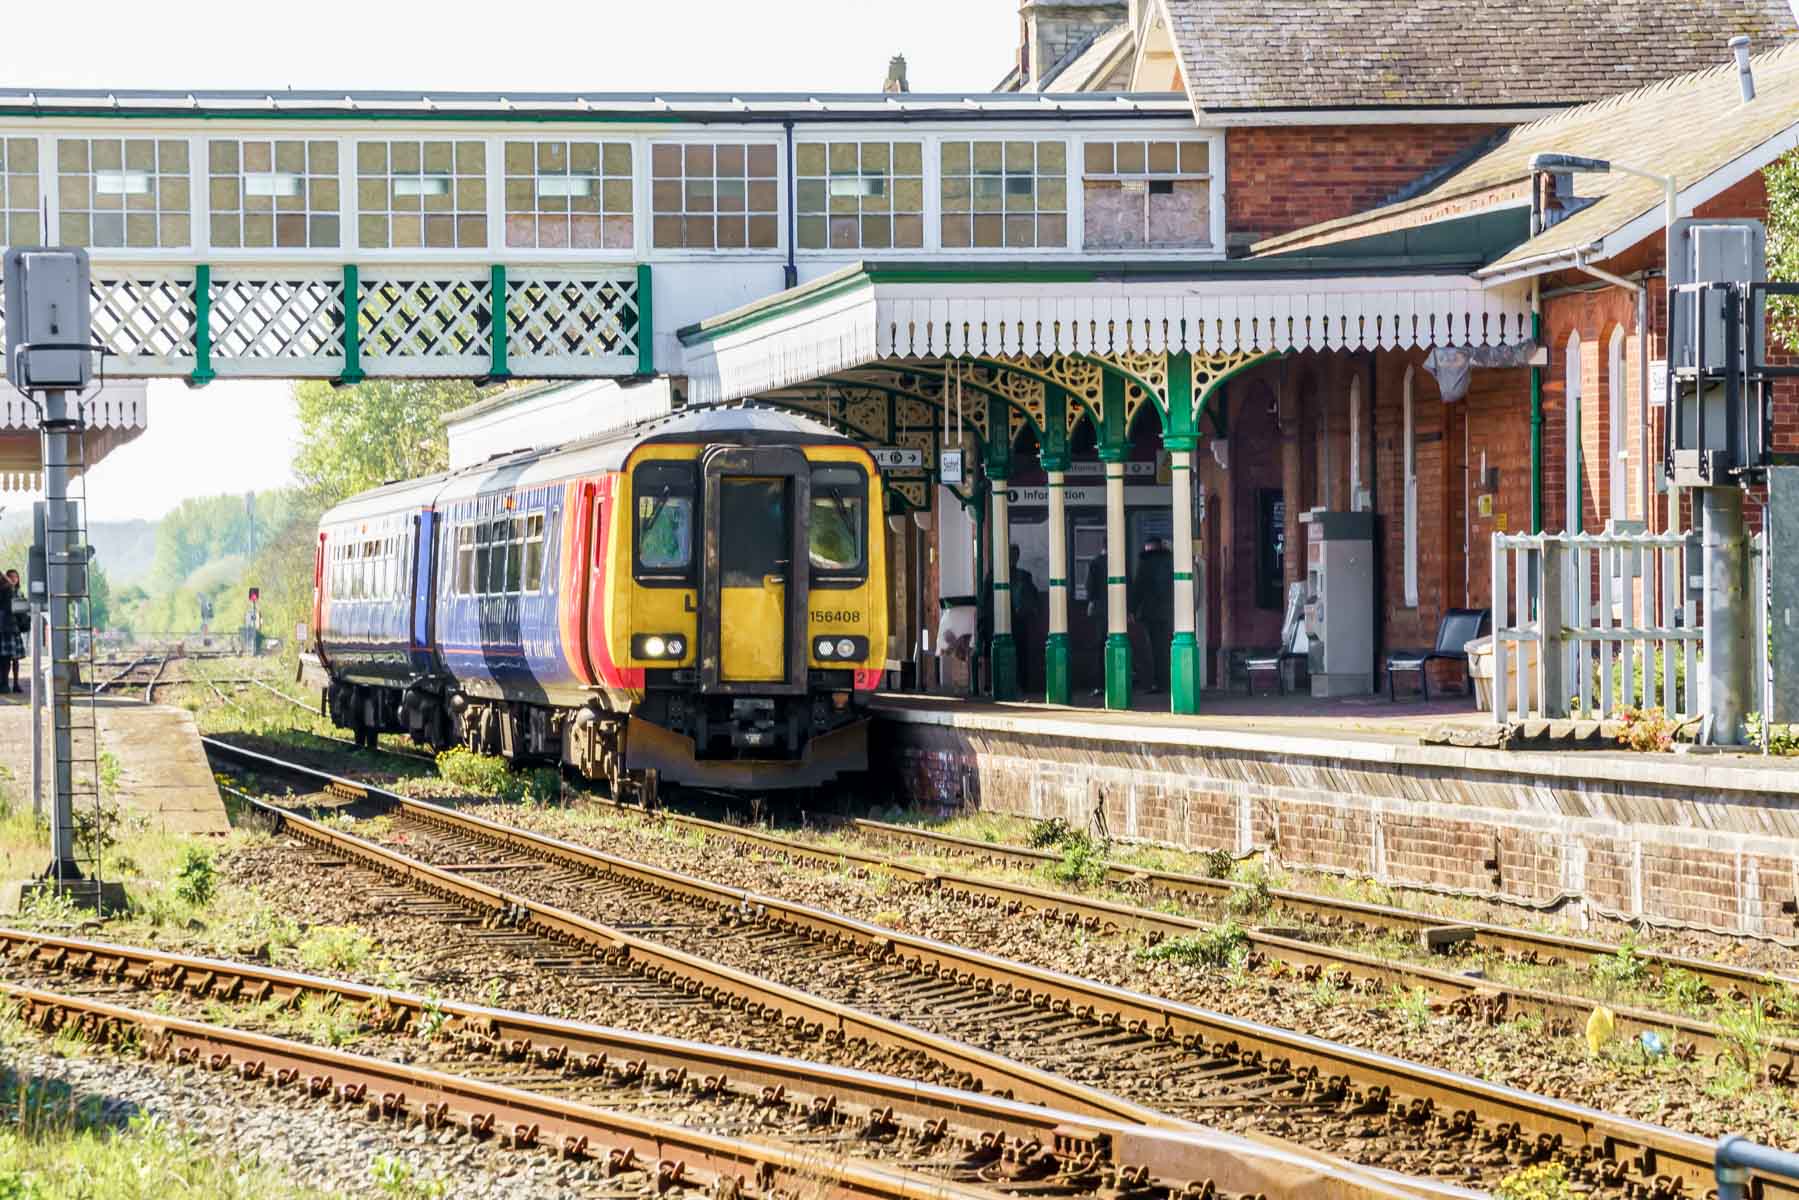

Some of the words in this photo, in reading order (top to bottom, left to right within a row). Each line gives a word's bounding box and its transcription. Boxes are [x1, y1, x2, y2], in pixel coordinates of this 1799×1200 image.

[1024, 489, 1085, 501] Infortion
[809, 611, 860, 623] 156408
[857, 671, 865, 683] 2
